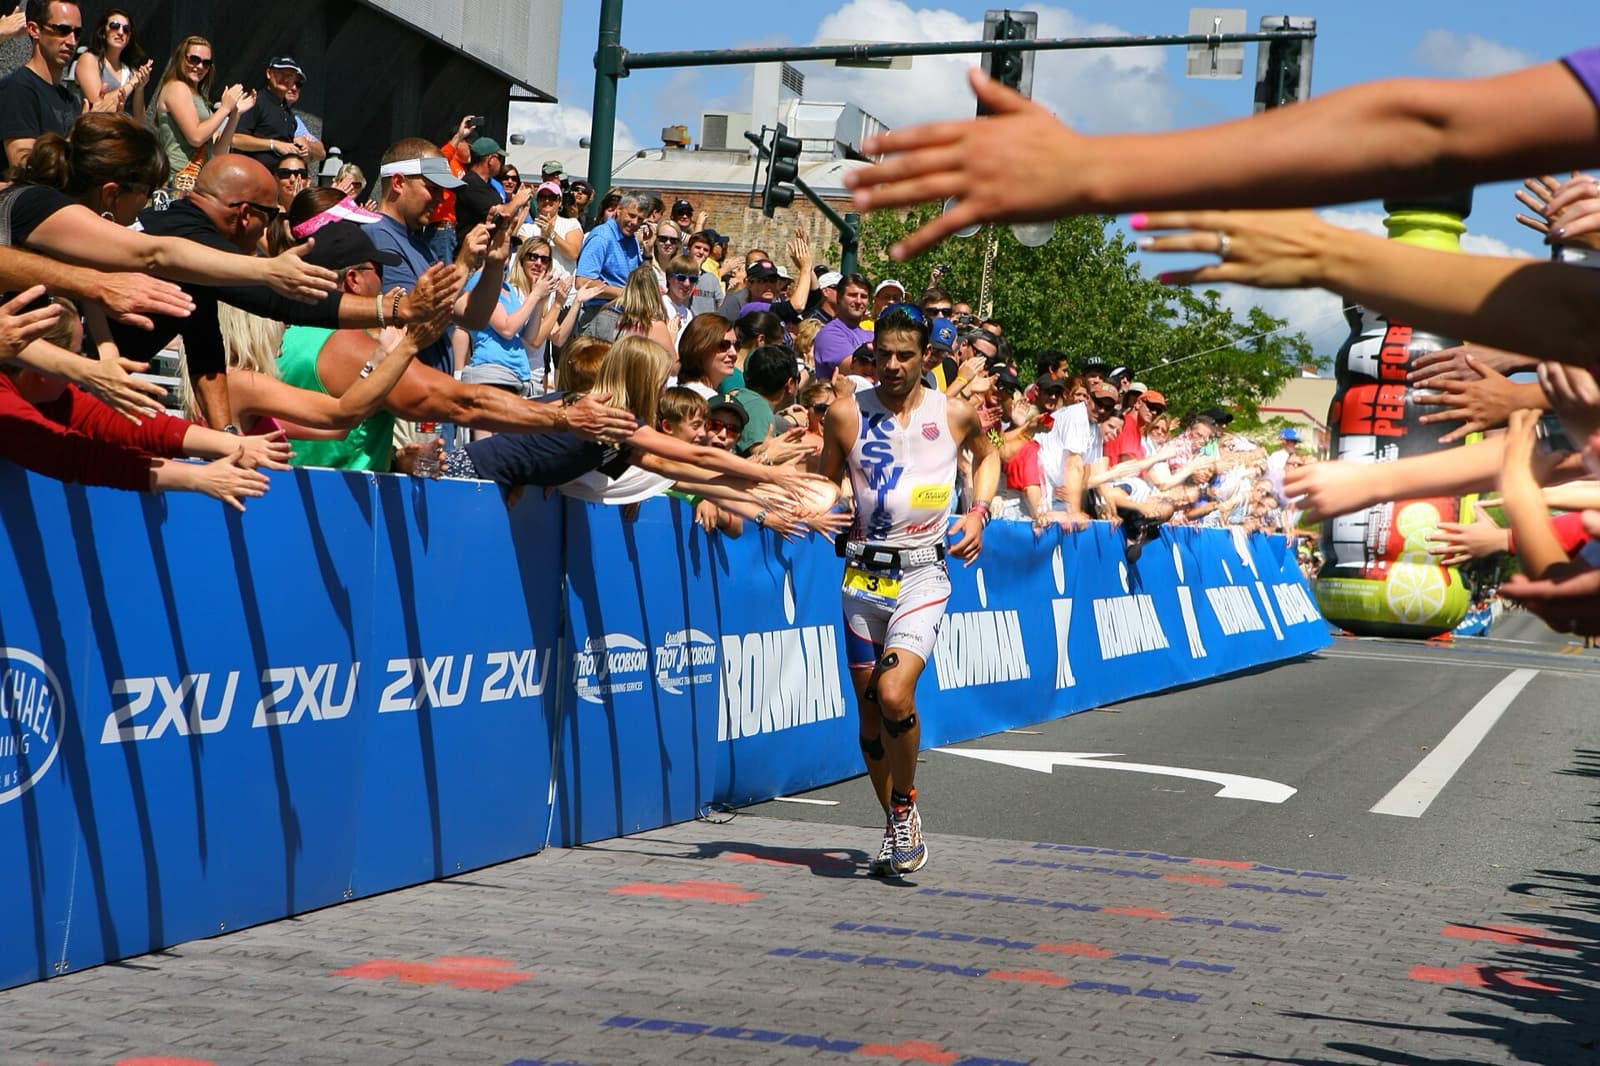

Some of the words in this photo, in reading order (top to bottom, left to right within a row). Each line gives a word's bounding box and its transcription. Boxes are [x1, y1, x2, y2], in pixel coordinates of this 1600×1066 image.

[866, 575, 880, 592] 3
[378, 653, 474, 713] 2XU
[481, 647, 552, 703] 2XU
[599, 650, 648, 680] JACOBSON
[656, 646, 678, 676] TROY
[676, 643, 717, 673] JACOBSON
[717, 624, 846, 742] IRONMAN
[1, 668, 56, 745] CHAEL
[100, 670, 241, 744] 2XU
[252, 661, 361, 728] 2XU
